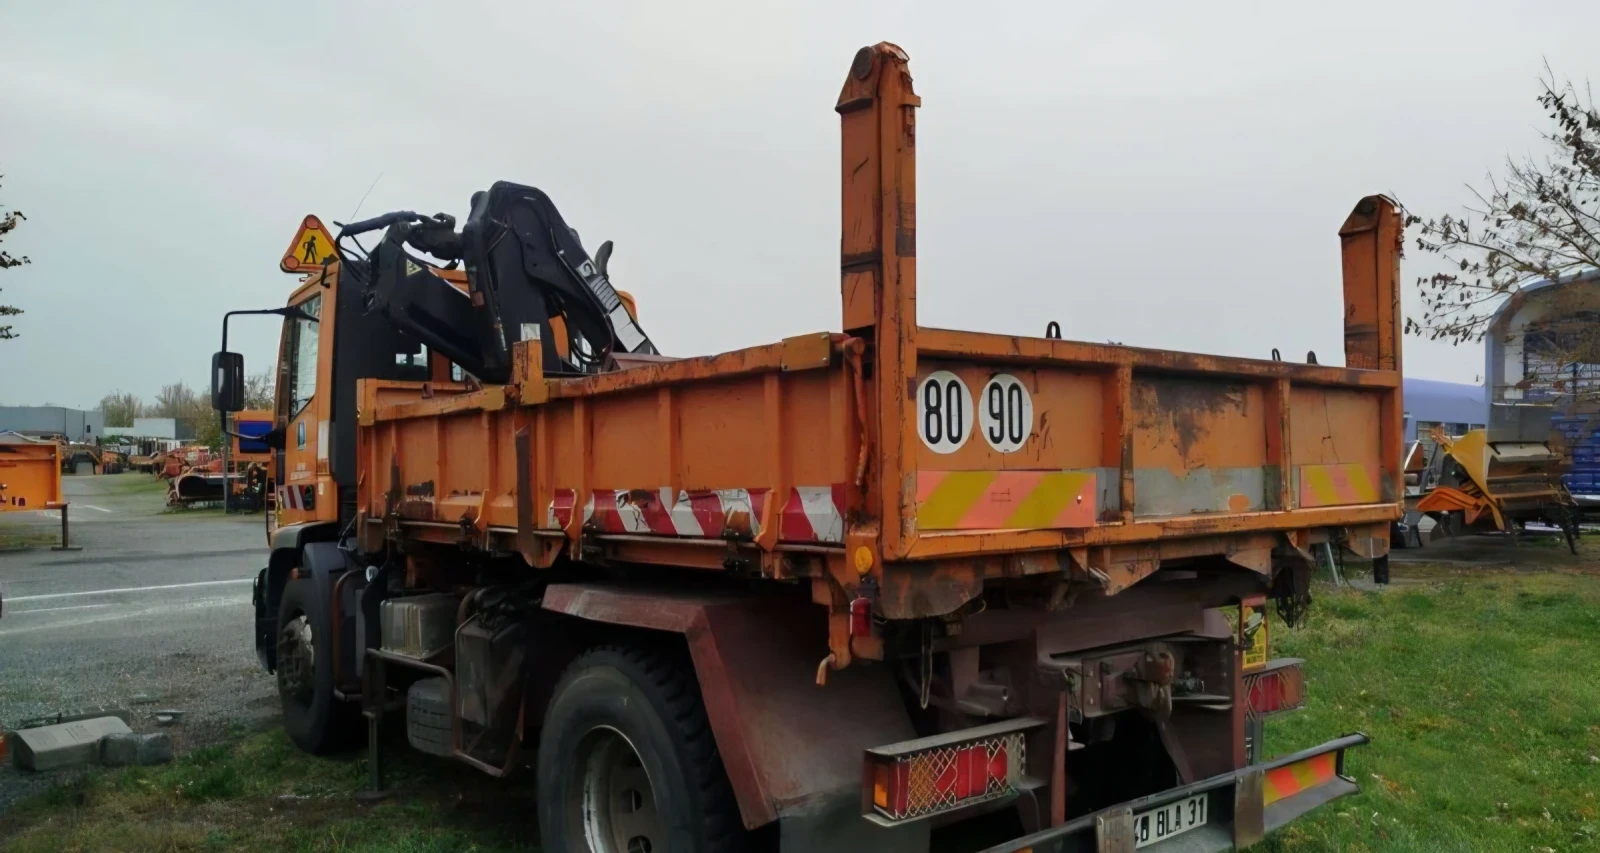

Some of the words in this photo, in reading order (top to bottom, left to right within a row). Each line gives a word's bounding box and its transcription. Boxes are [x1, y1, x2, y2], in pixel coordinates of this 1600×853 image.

[925, 379, 962, 444] 80
[989, 382, 1023, 444] 90
[1157, 805, 1181, 837] BLA
[1188, 797, 1204, 826] 31
